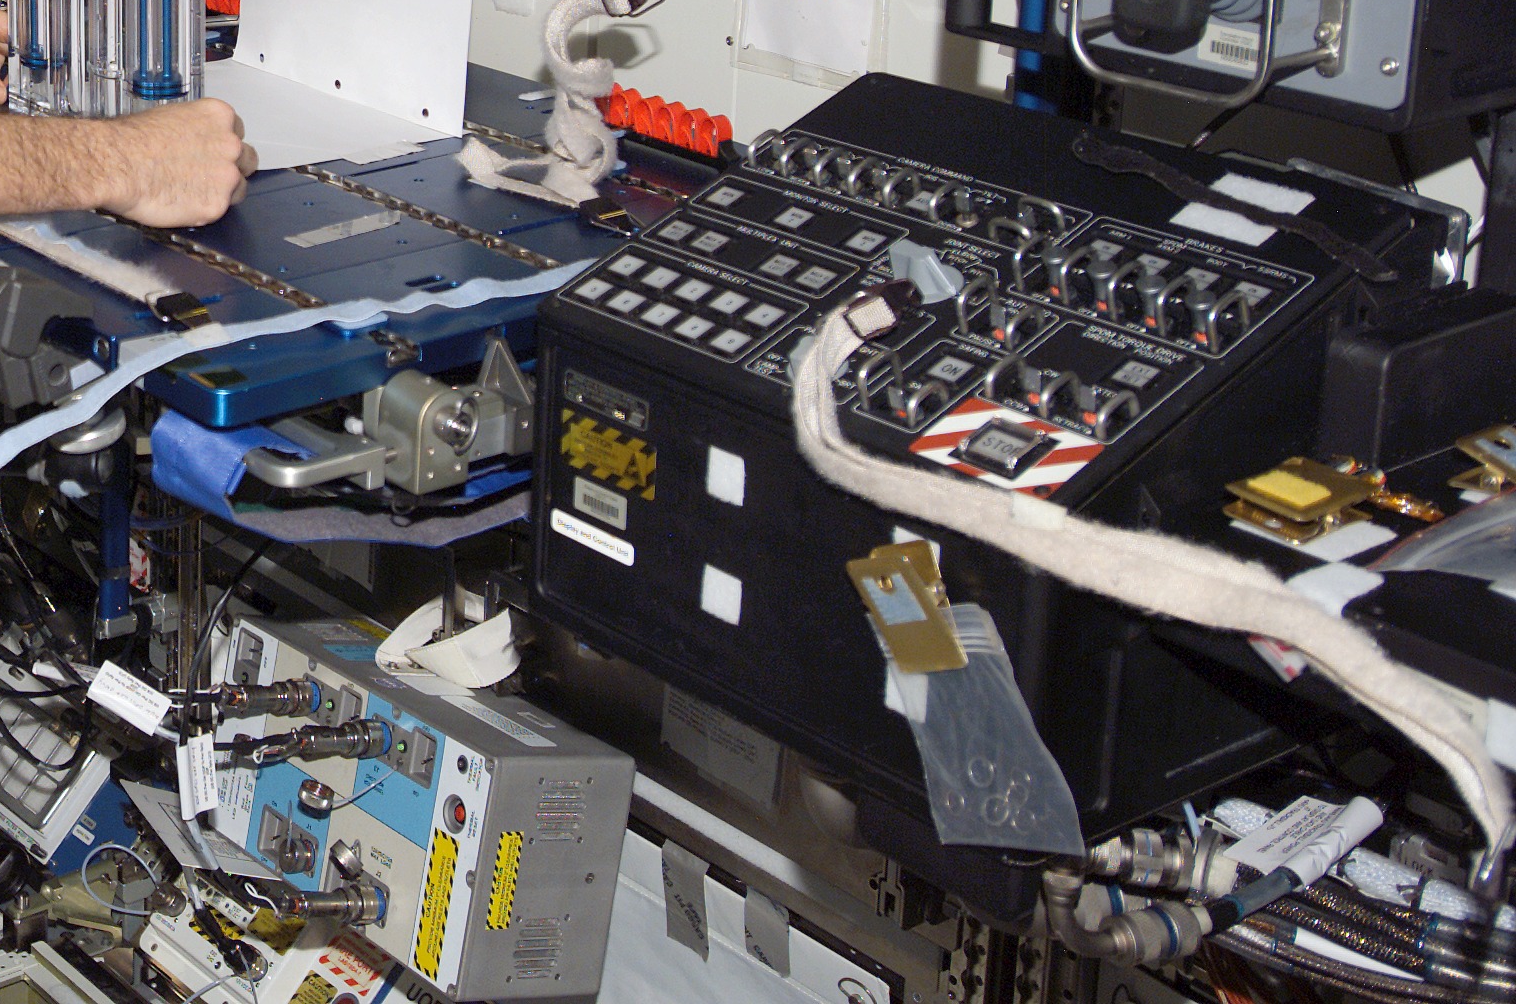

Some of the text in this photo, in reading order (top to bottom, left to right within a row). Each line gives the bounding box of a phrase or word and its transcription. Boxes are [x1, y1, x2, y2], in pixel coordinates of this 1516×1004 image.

[1185, 238, 1224, 254] BRAKES
[940, 363, 963, 375] ON
[426, 883, 435, 918] CAUTION
